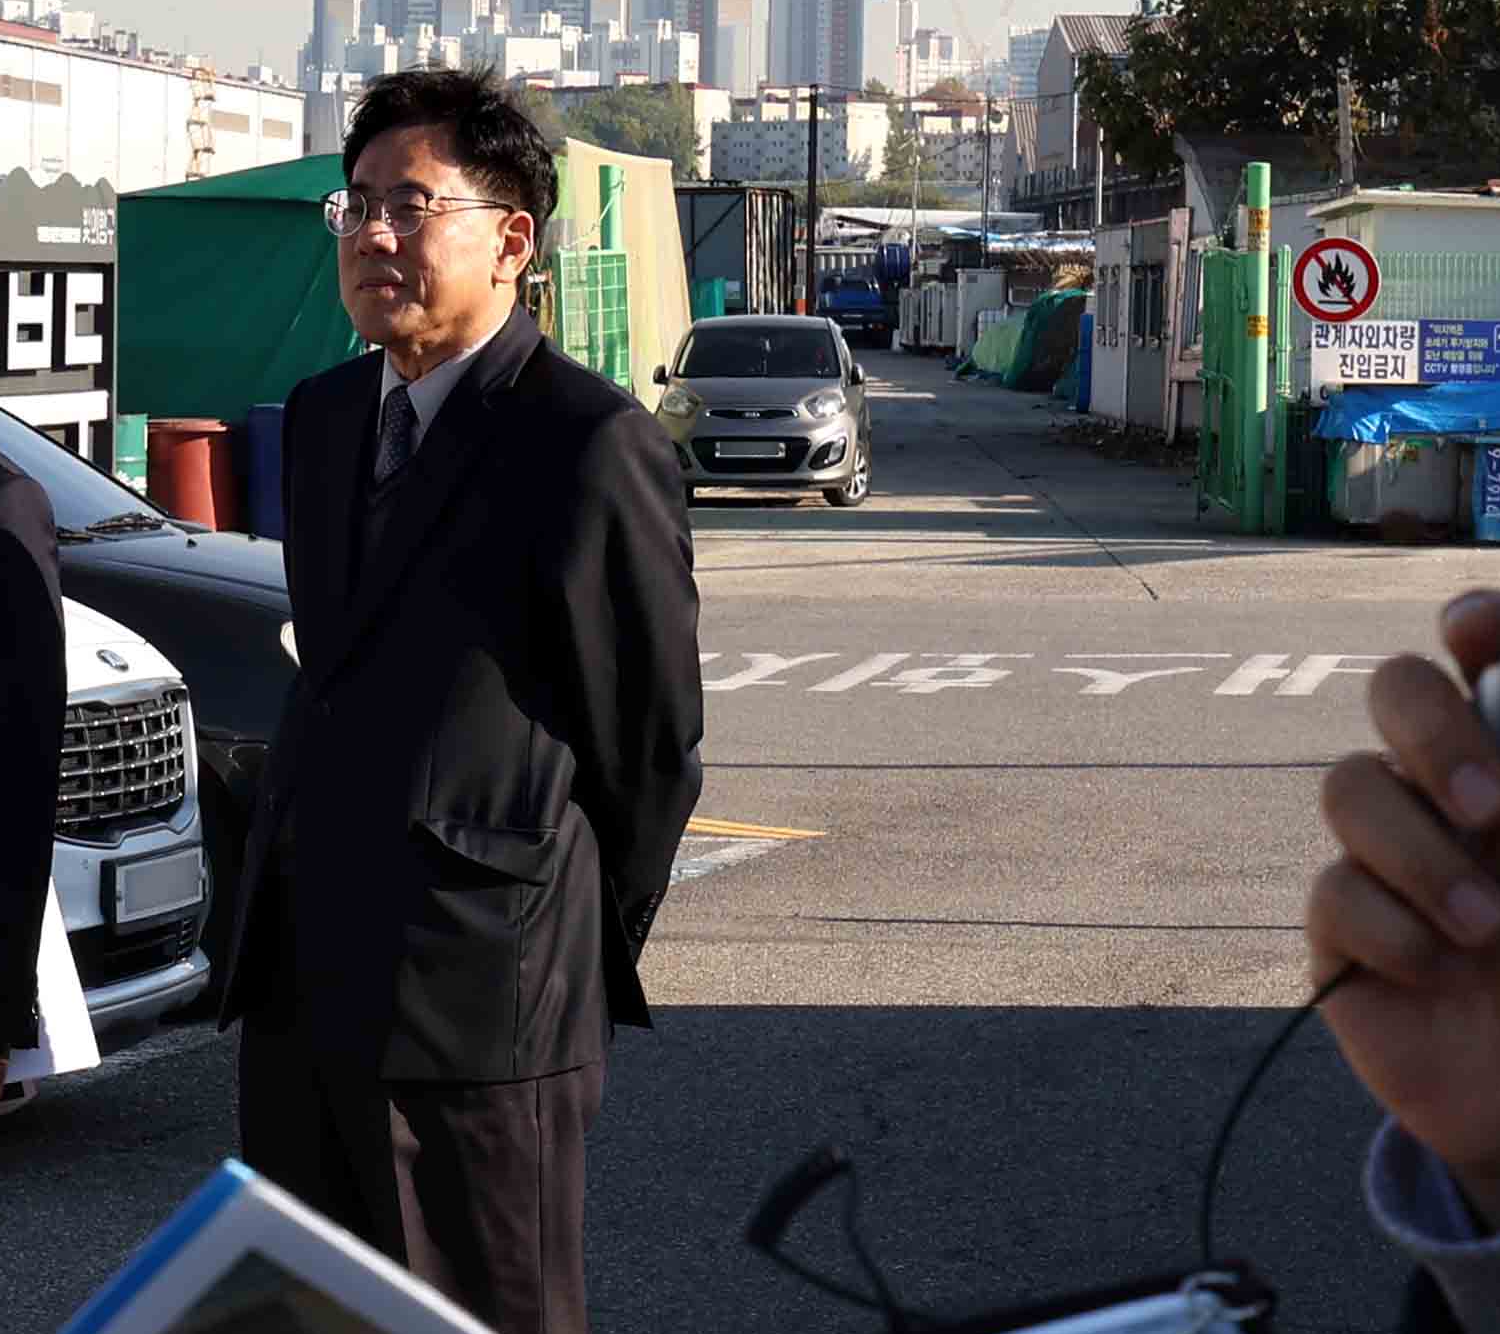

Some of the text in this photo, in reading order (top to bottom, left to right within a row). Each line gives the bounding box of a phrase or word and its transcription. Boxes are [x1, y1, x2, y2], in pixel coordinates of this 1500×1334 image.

[1314, 324, 1415, 349] 관계자외차량
[1339, 353, 1406, 380] 진입금지
[1424, 363, 1448, 374] CCTV
